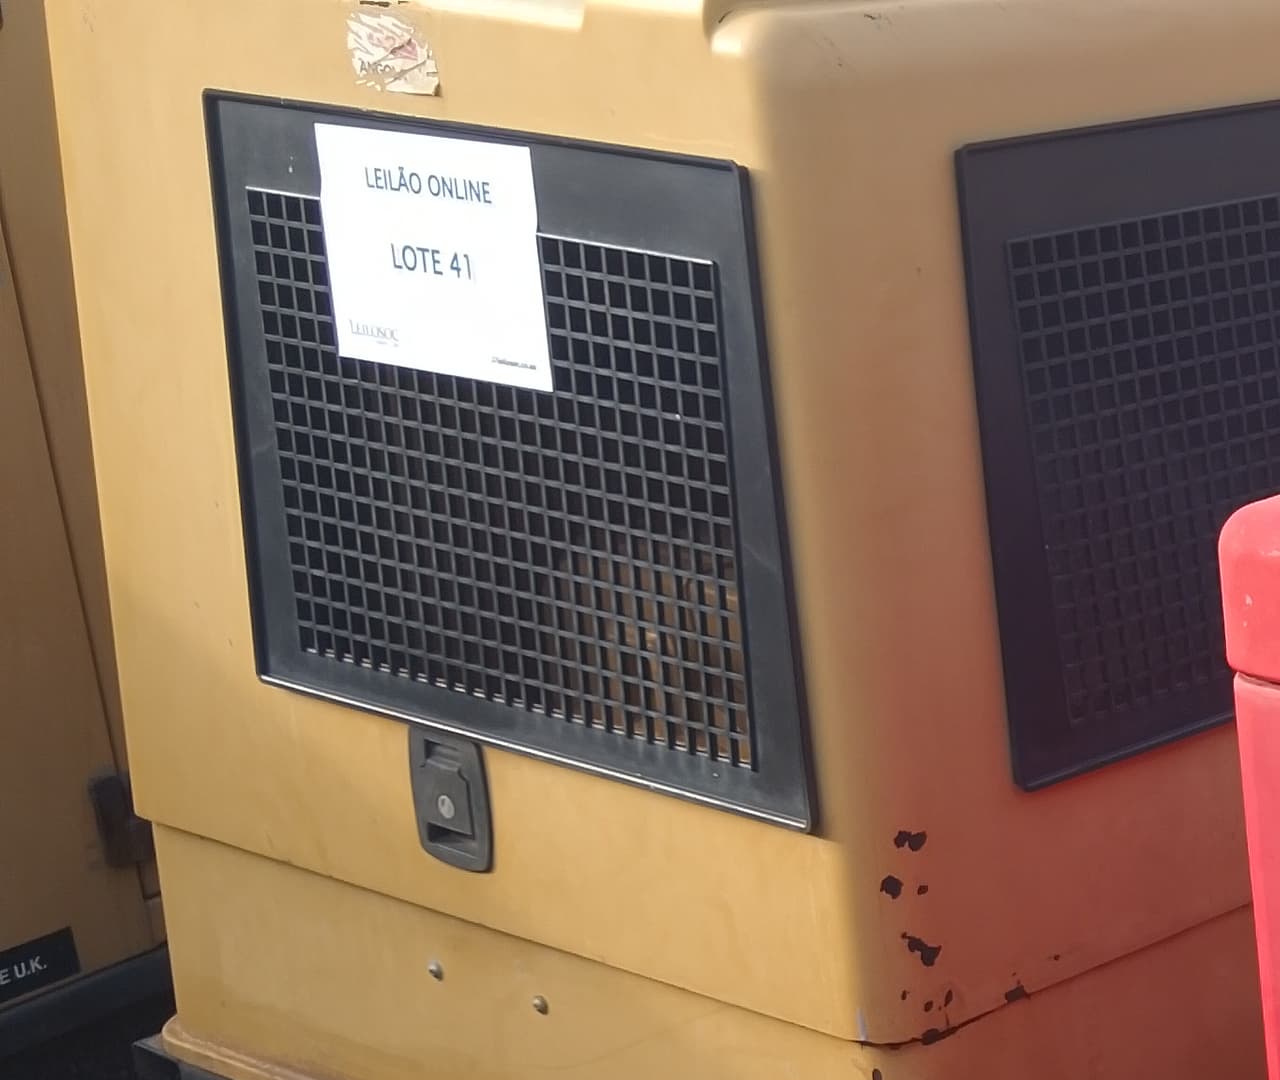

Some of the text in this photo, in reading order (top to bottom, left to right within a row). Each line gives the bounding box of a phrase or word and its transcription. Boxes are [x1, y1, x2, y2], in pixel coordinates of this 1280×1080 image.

[365, 166, 492, 204] LEILÃO ONLINE
[391, 243, 472, 280] LOTE 41
[13, 955, 47, 979] U.K.
